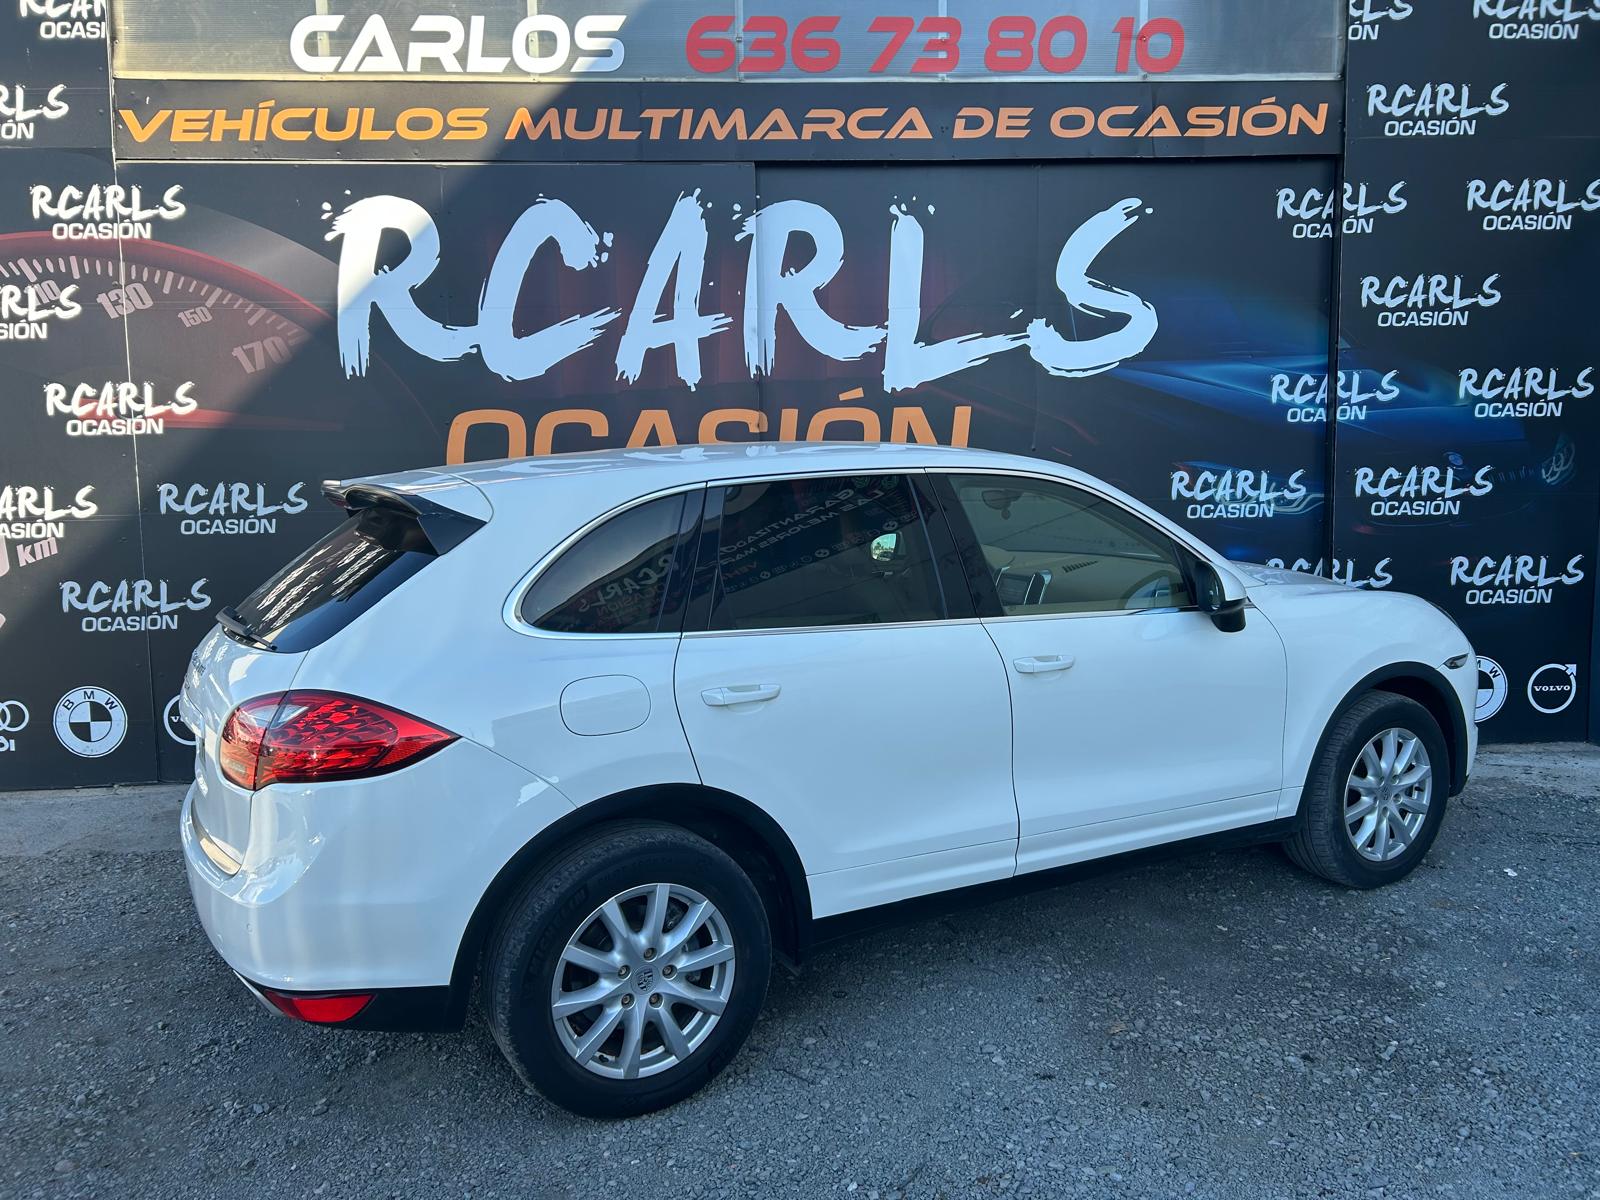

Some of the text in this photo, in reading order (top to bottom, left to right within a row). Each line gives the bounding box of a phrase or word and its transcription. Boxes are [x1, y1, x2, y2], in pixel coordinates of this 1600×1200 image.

[288, 13, 1185, 74] CARLOS 636 73 80 10
[1489, 18, 1578, 39] OCASIÓN
[1367, 83, 1509, 119] RCARLS
[118, 97, 1329, 143] VEHÍCULOS MULTIMARCA DE OCASIÓN
[1385, 115, 1476, 136] OCASIÓN
[30, 180, 186, 221] RCARLS
[1464, 176, 1600, 214] RCARLS
[52, 217, 151, 242] OCASIÓN
[1483, 210, 1571, 230] OCASIÓN
[0, 283, 82, 321] RLS
[96, 282, 153, 319] 130
[322, 188, 1159, 392] RCARLS
[1361, 274, 1501, 309] RCARLS
[178, 306, 213, 328] 150
[1376, 306, 1469, 327] OCASIÓN
[231, 335, 292, 374] 170
[44, 376, 197, 419] RCARLS
[1459, 367, 1594, 400] RCARLS
[1475, 396, 1562, 417] OCASIÓN
[67, 415, 163, 437] OCASIÓN
[1169, 469, 1308, 502] RCARLS
[1355, 465, 1492, 498] RCARLS
[0, 483, 99, 522] ARLS
[157, 482, 308, 517] RCARLS
[1186, 501, 1275, 519] OCASIÓN
[1370, 498, 1461, 516] OCASIÓN
[0, 518, 65, 541] ASIÓN
[181, 514, 276, 534] OCASIÓN
[16, 537, 59, 568] km
[1451, 555, 1584, 587] RCARLS
[60, 578, 211, 614] RCARLS
[1466, 582, 1552, 604] OCASIÓN
[82, 610, 177, 632] OCASIÓN
[1533, 684, 1571, 693] VOLVO
